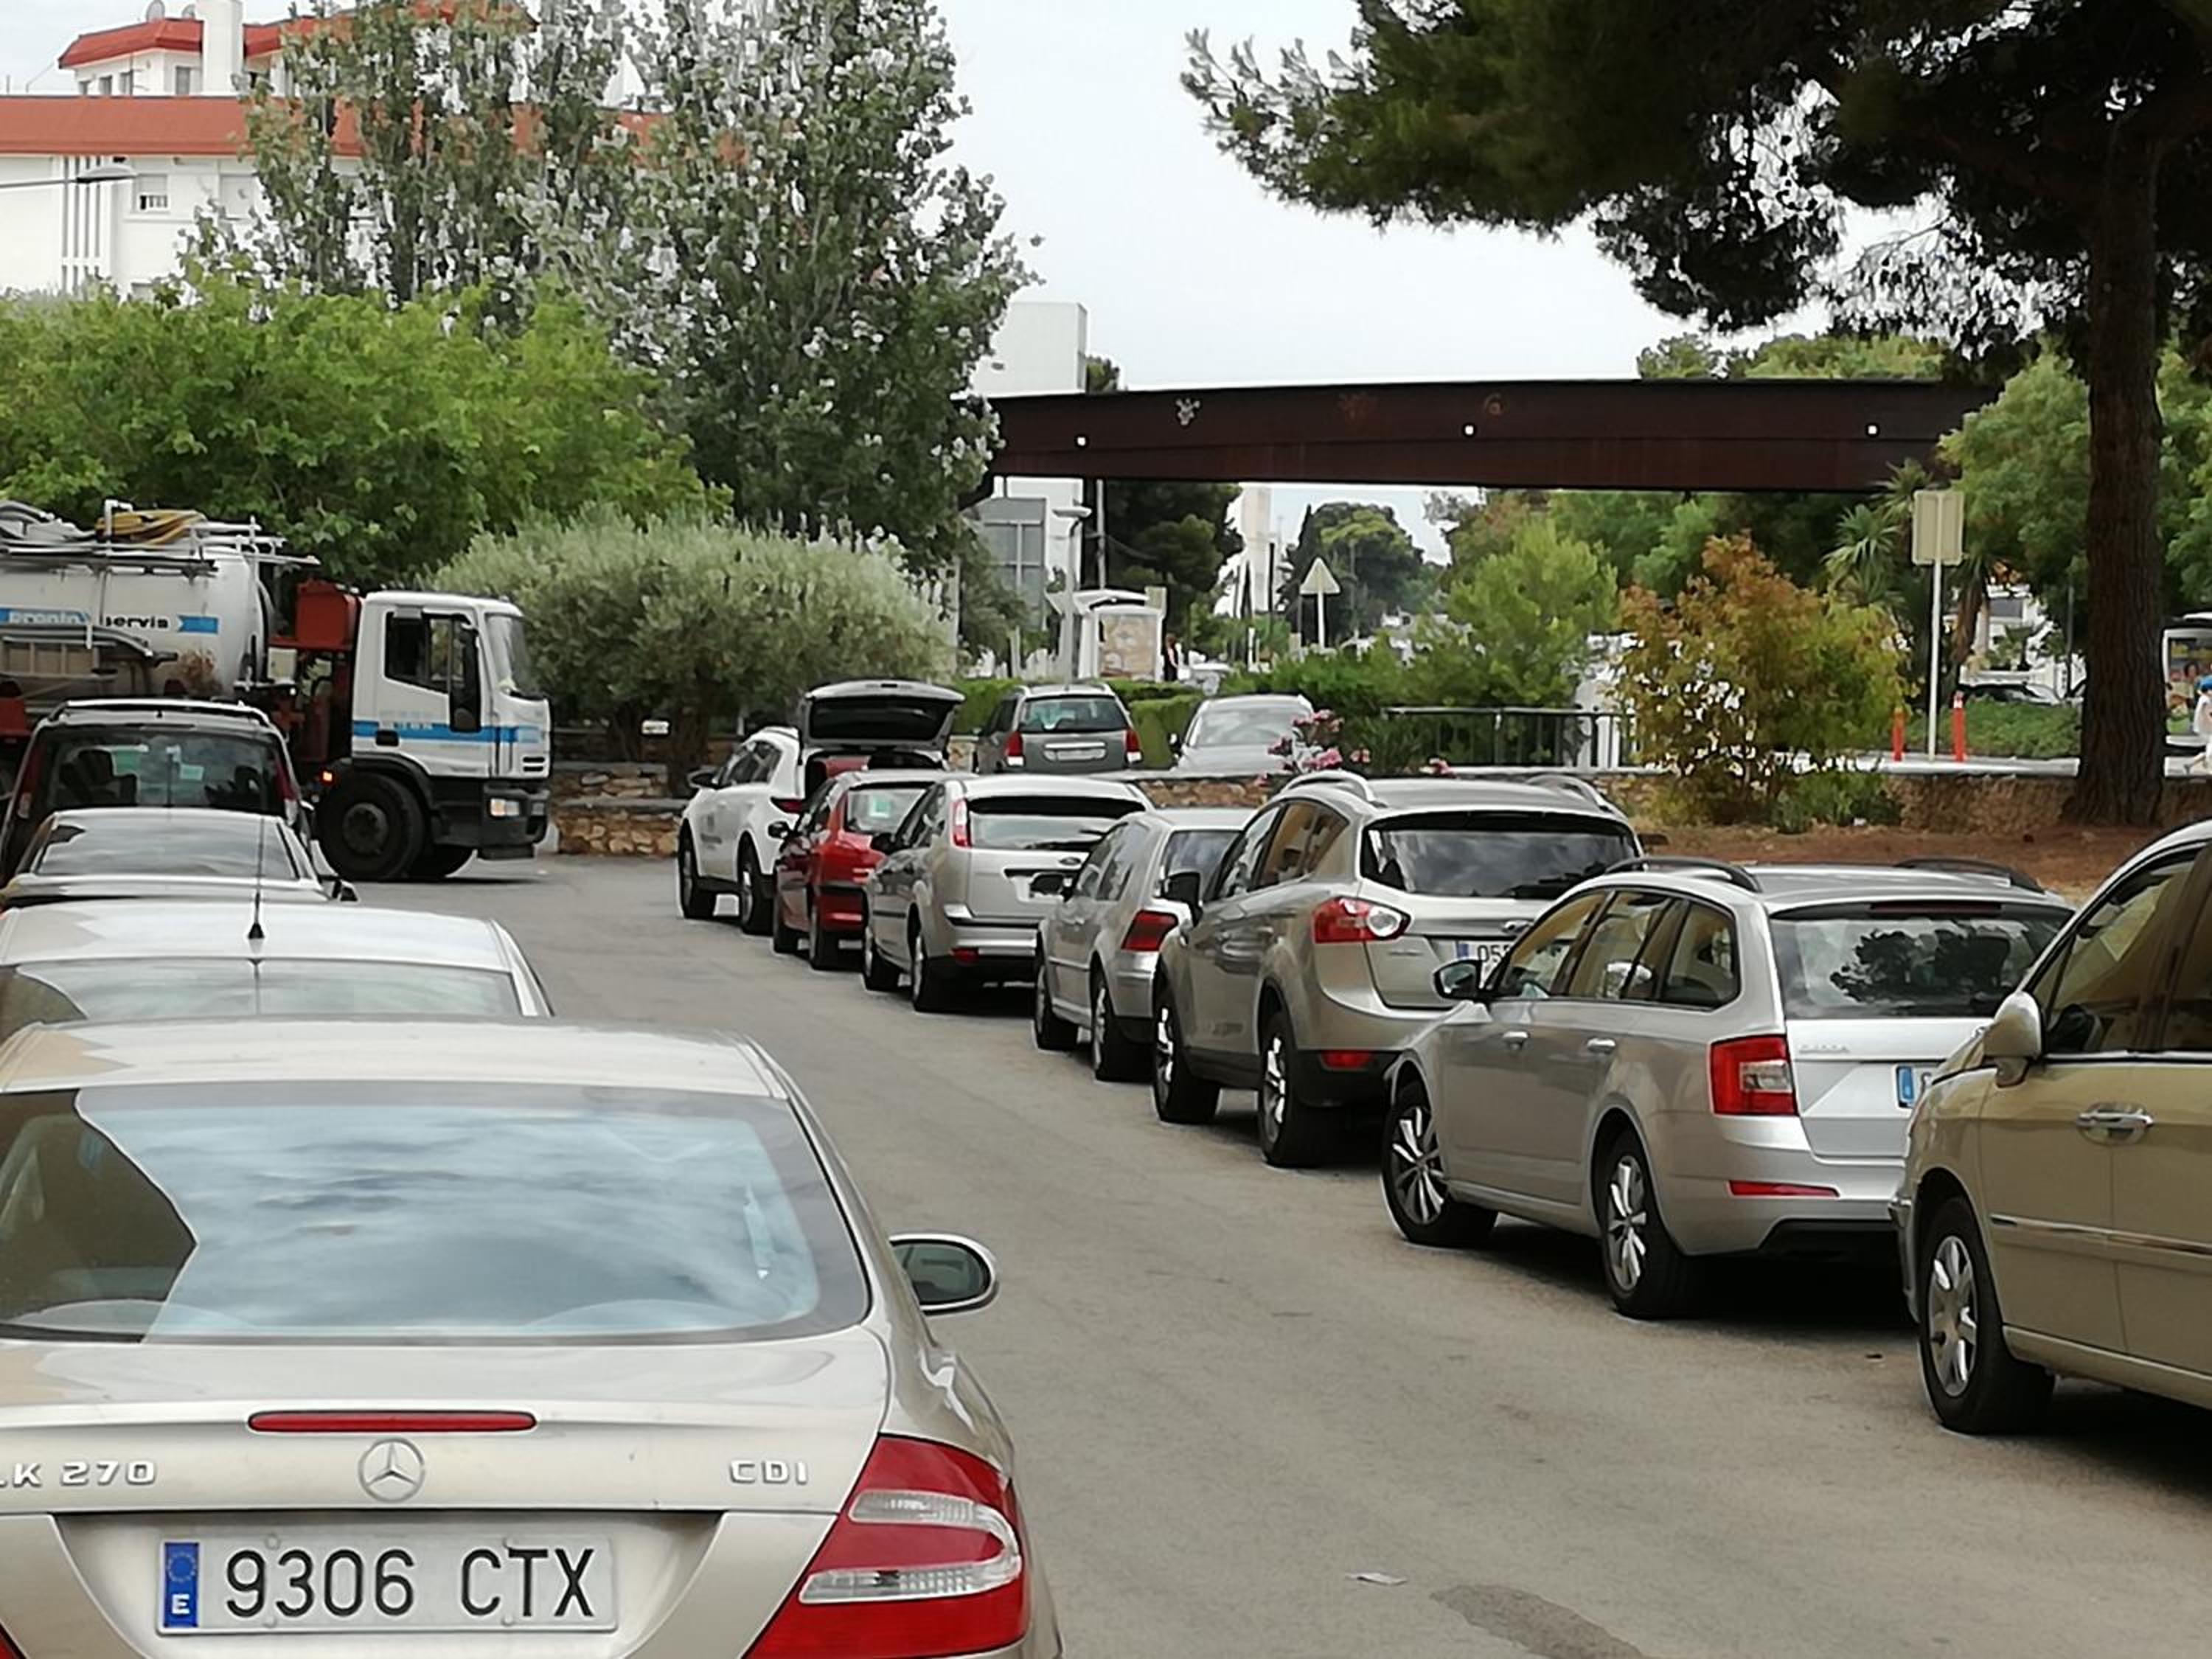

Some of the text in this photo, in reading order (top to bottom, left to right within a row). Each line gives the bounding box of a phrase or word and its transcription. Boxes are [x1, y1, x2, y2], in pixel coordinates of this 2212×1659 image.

[60, 1461, 156, 1486] 270
[729, 1460, 808, 1485] CDI
[226, 1548, 594, 1618] 9306 CTX
[172, 1593, 190, 1615] E
